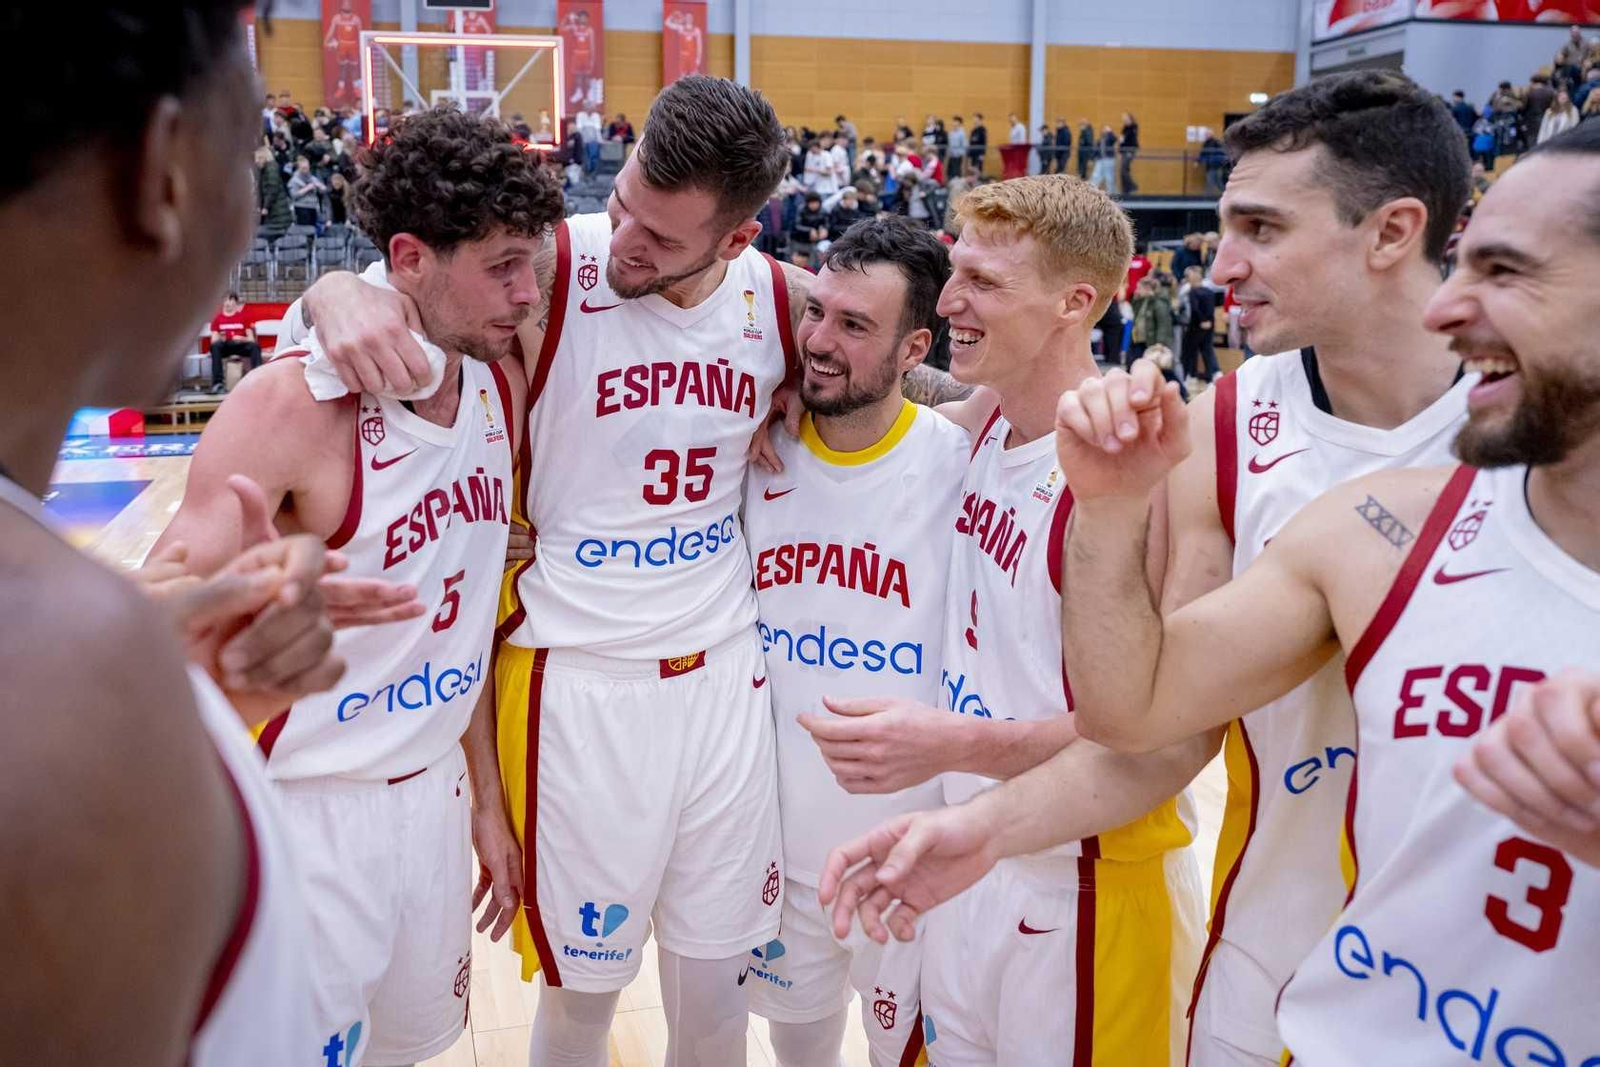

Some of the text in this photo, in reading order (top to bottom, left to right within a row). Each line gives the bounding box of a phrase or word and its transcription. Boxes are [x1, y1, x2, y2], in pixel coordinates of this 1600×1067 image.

[596, 358, 756, 419] ESPAÑA
[642, 447, 717, 505] 35
[383, 467, 508, 571] ESPAÑA
[575, 513, 735, 567] endesa
[431, 569, 465, 633] 5
[756, 542, 910, 608] ESPAÑA
[756, 621, 922, 674] endesa
[1484, 835, 1574, 953] 3
[1334, 925, 1600, 1067] ende
